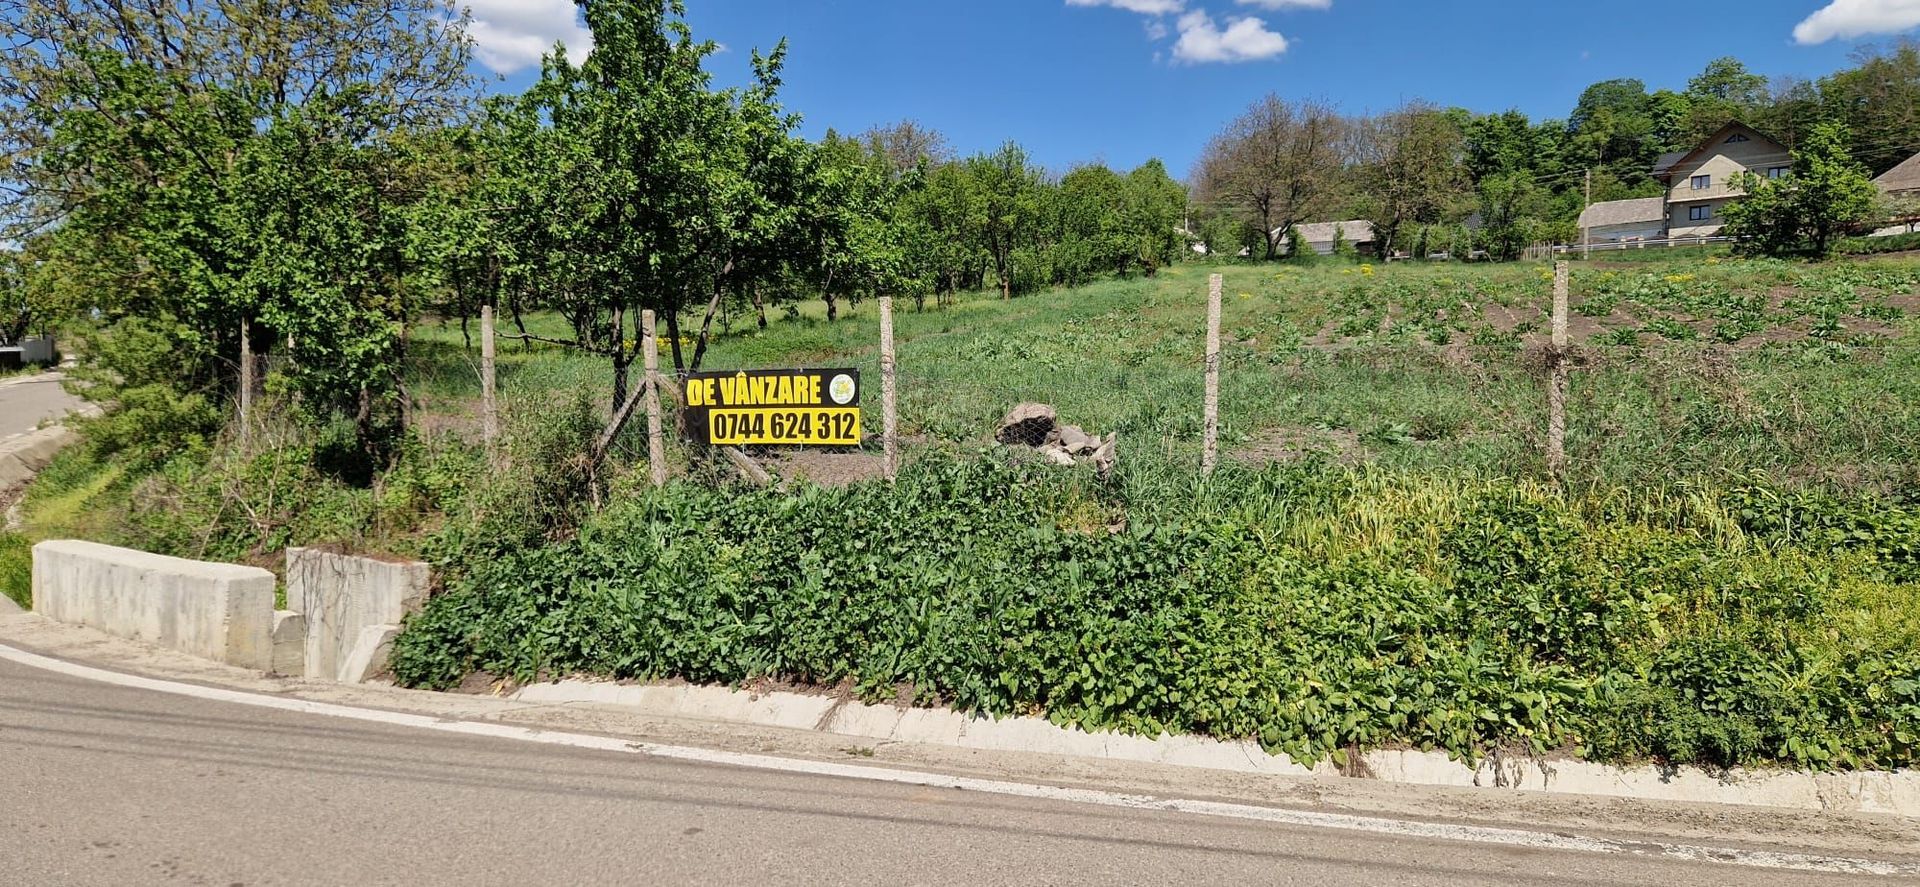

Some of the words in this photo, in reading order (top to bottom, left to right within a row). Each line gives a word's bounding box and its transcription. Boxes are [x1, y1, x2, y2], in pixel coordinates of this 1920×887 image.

[687, 379, 717, 406] DE
[719, 371, 822, 405] VÂNZARE
[713, 413, 765, 439] 0744
[770, 412, 812, 439] 624
[817, 412, 856, 439] 312
